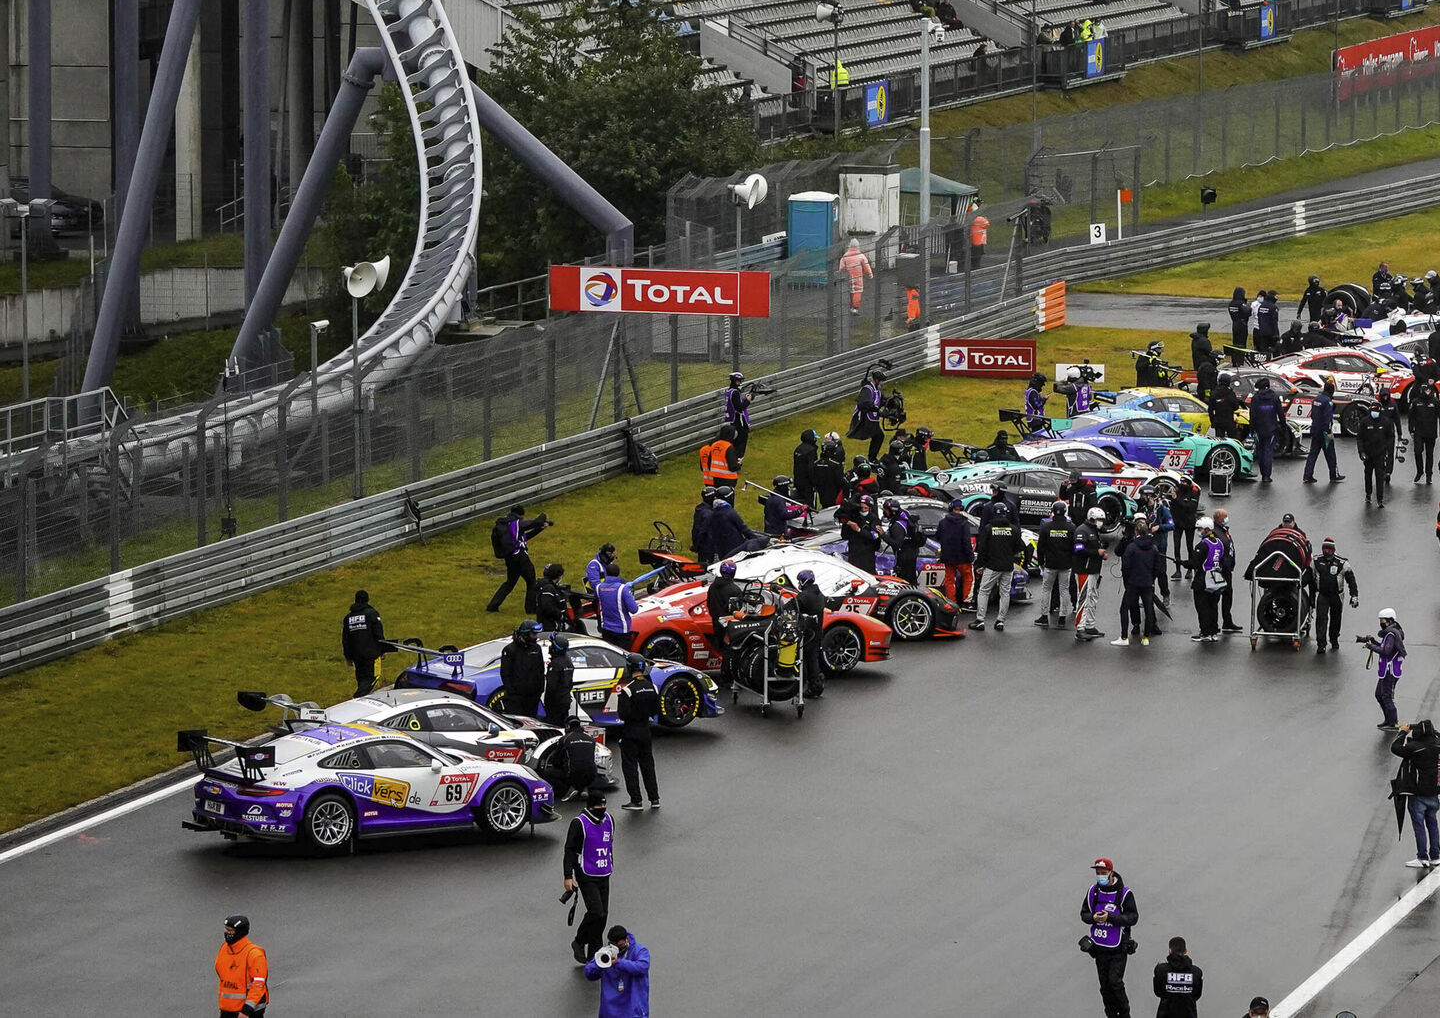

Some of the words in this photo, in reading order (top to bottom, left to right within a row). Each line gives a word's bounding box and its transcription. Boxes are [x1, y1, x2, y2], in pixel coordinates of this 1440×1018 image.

[1094, 225, 1102, 238] 3
[627, 279, 734, 305] TOTAL
[970, 352, 1029, 366] TOTAL
[1297, 405, 1303, 416] 6
[1169, 455, 1181, 467] 33
[925, 572, 937, 586] 16
[580, 691, 605, 702] HFG
[445, 784, 463, 802] 69
[596, 848, 608, 856] TV
[1167, 972, 1193, 982] HFG
